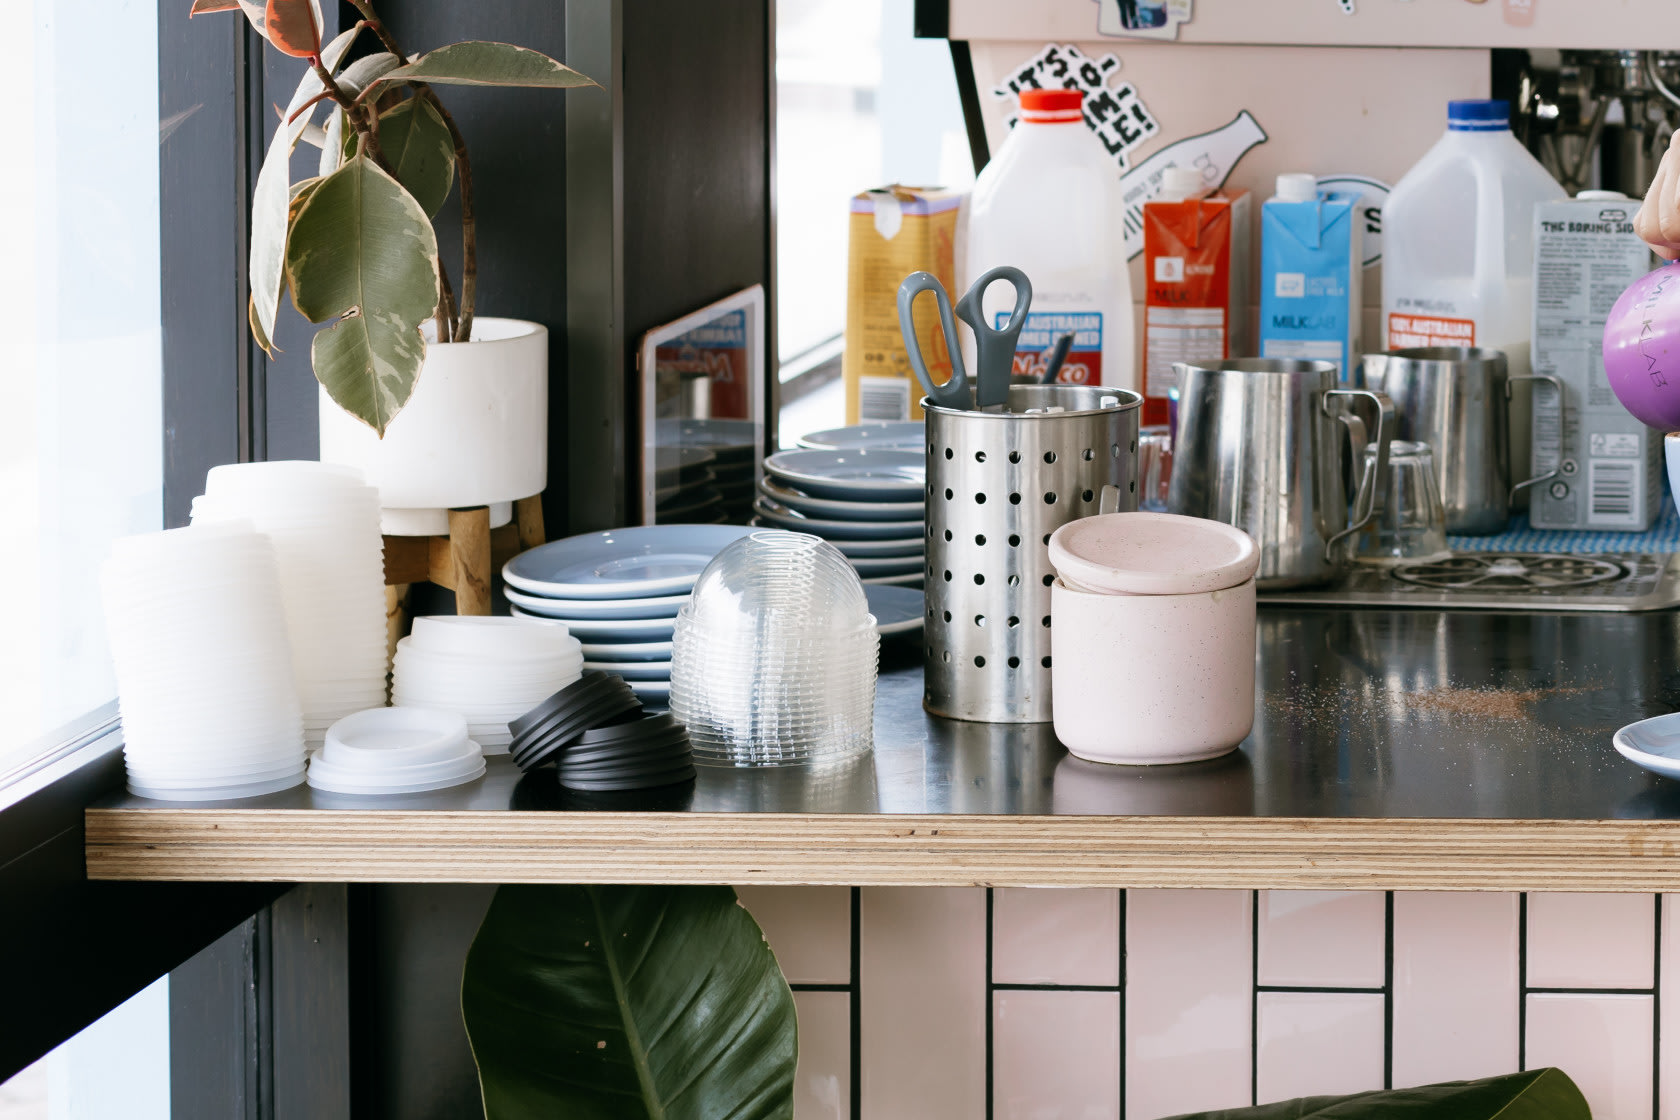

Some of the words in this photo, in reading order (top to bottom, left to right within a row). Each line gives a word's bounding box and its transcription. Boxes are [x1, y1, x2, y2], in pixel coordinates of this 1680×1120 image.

[1541, 221, 1565, 232] THE
[1568, 222, 1612, 233] BORING
[1616, 223, 1634, 233] SID
[1272, 315, 1336, 329] MILKLAB
[1638, 274, 1673, 388] MILKLAB
